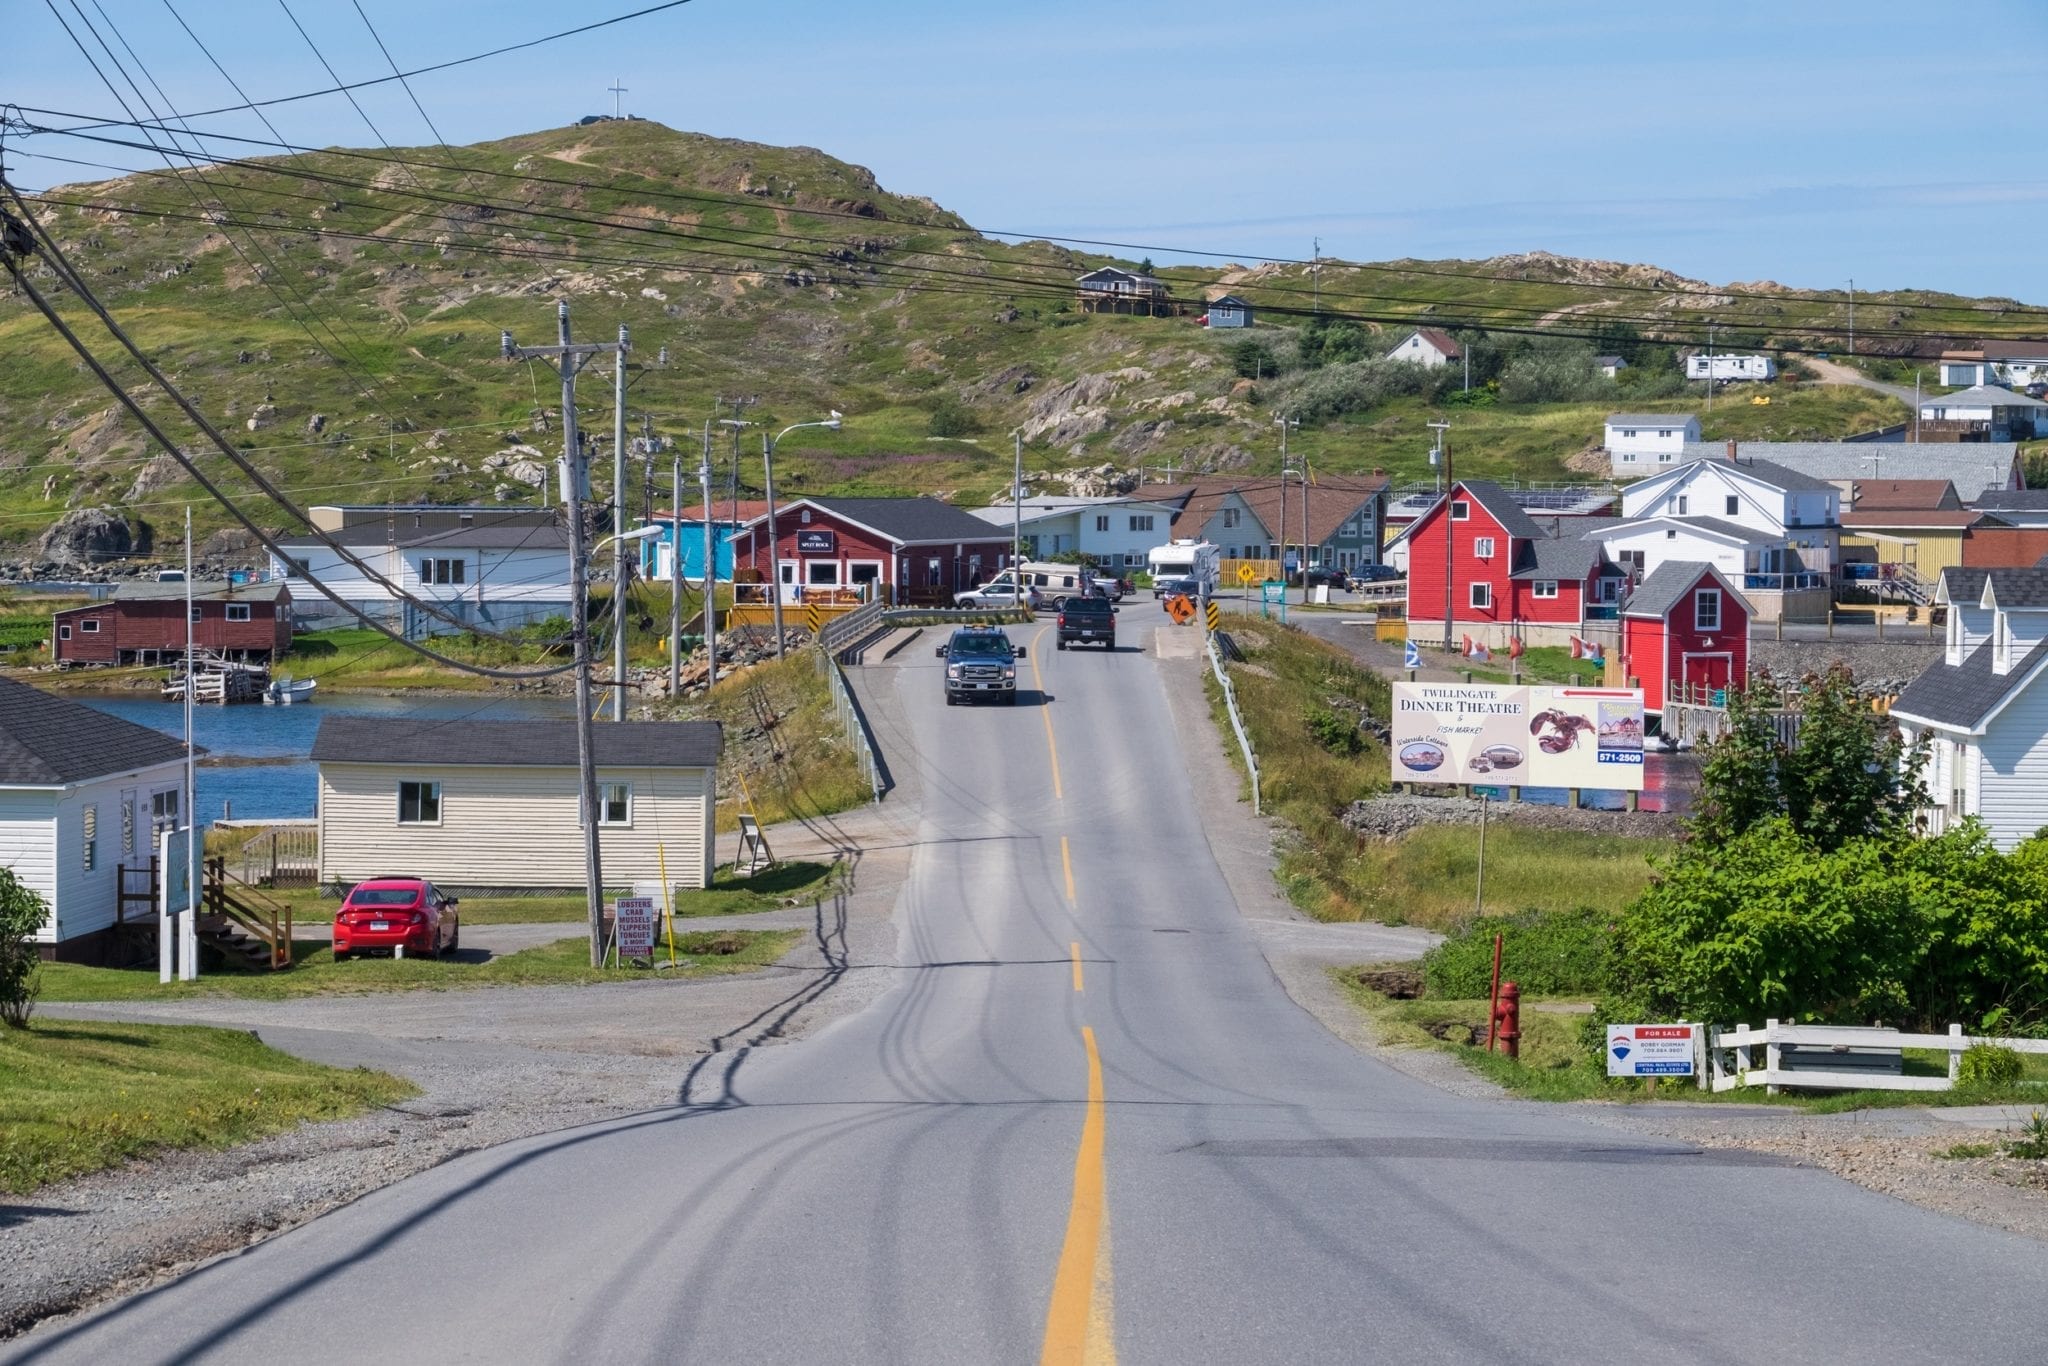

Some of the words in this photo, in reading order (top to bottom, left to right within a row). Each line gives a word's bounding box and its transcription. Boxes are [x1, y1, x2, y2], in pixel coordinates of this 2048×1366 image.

[1422, 689, 1497, 699] TWILLINGATE
[1436, 726, 1453, 734] FISH
[1454, 726, 1484, 735] MARKET
[1599, 753, 1641, 762] 571-2509
